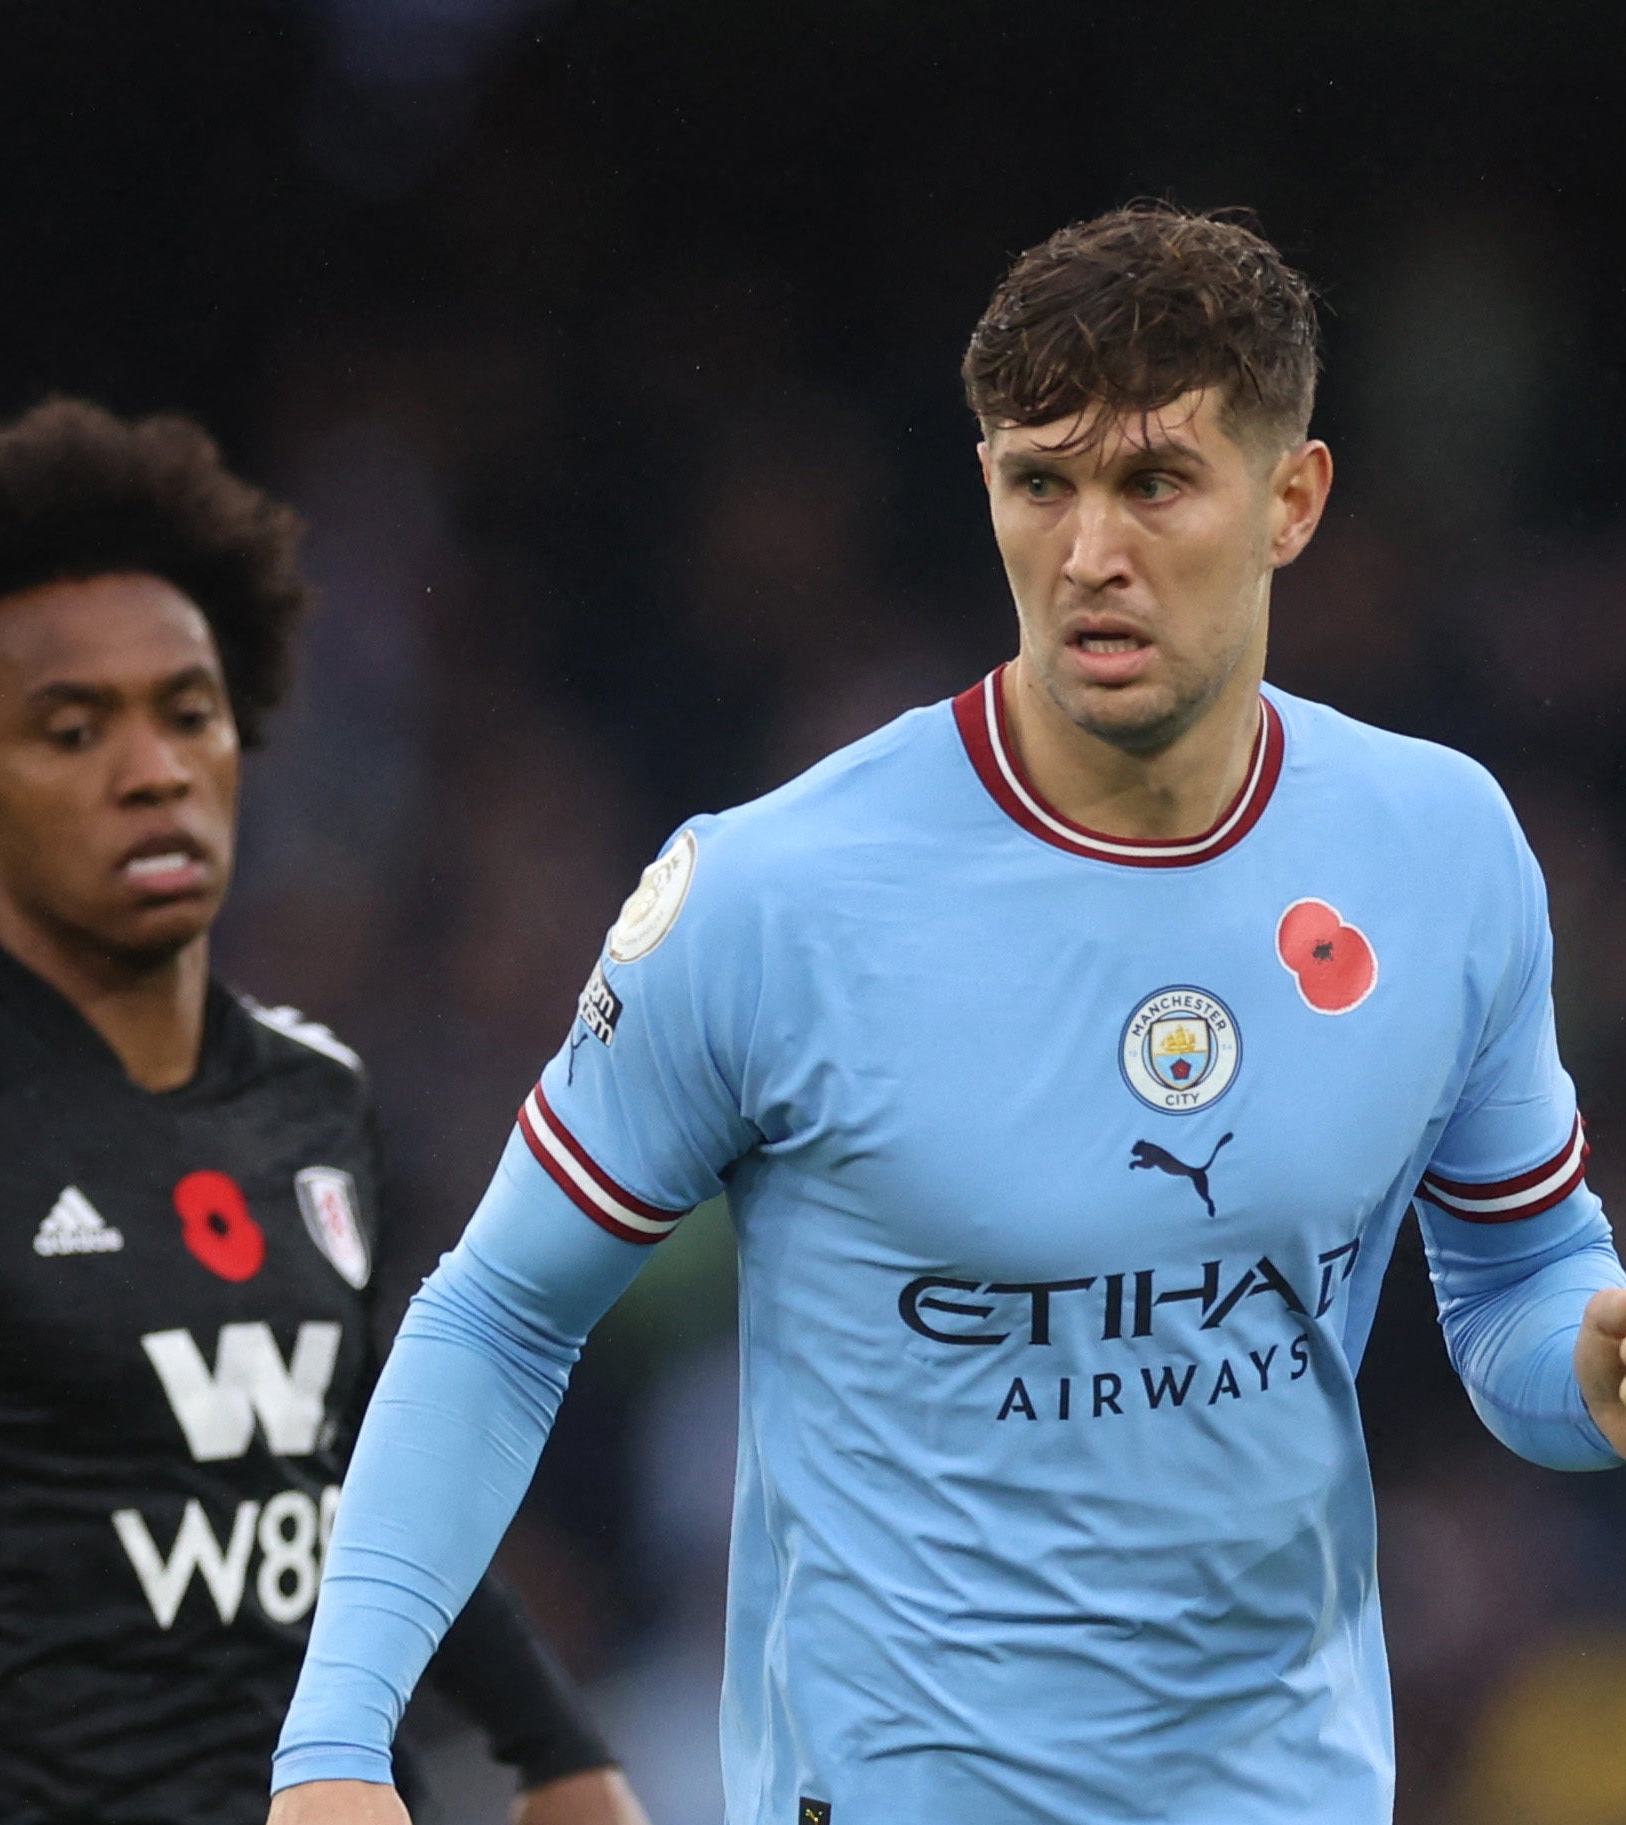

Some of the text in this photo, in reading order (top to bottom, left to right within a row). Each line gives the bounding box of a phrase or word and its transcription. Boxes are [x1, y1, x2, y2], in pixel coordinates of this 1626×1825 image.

[1132, 996, 1226, 1037] MANCHESTER
[1165, 1093, 1200, 1106] CITY
[996, 1333, 1310, 1421] AIRWAYS
[111, 1485, 341, 1632] W8
